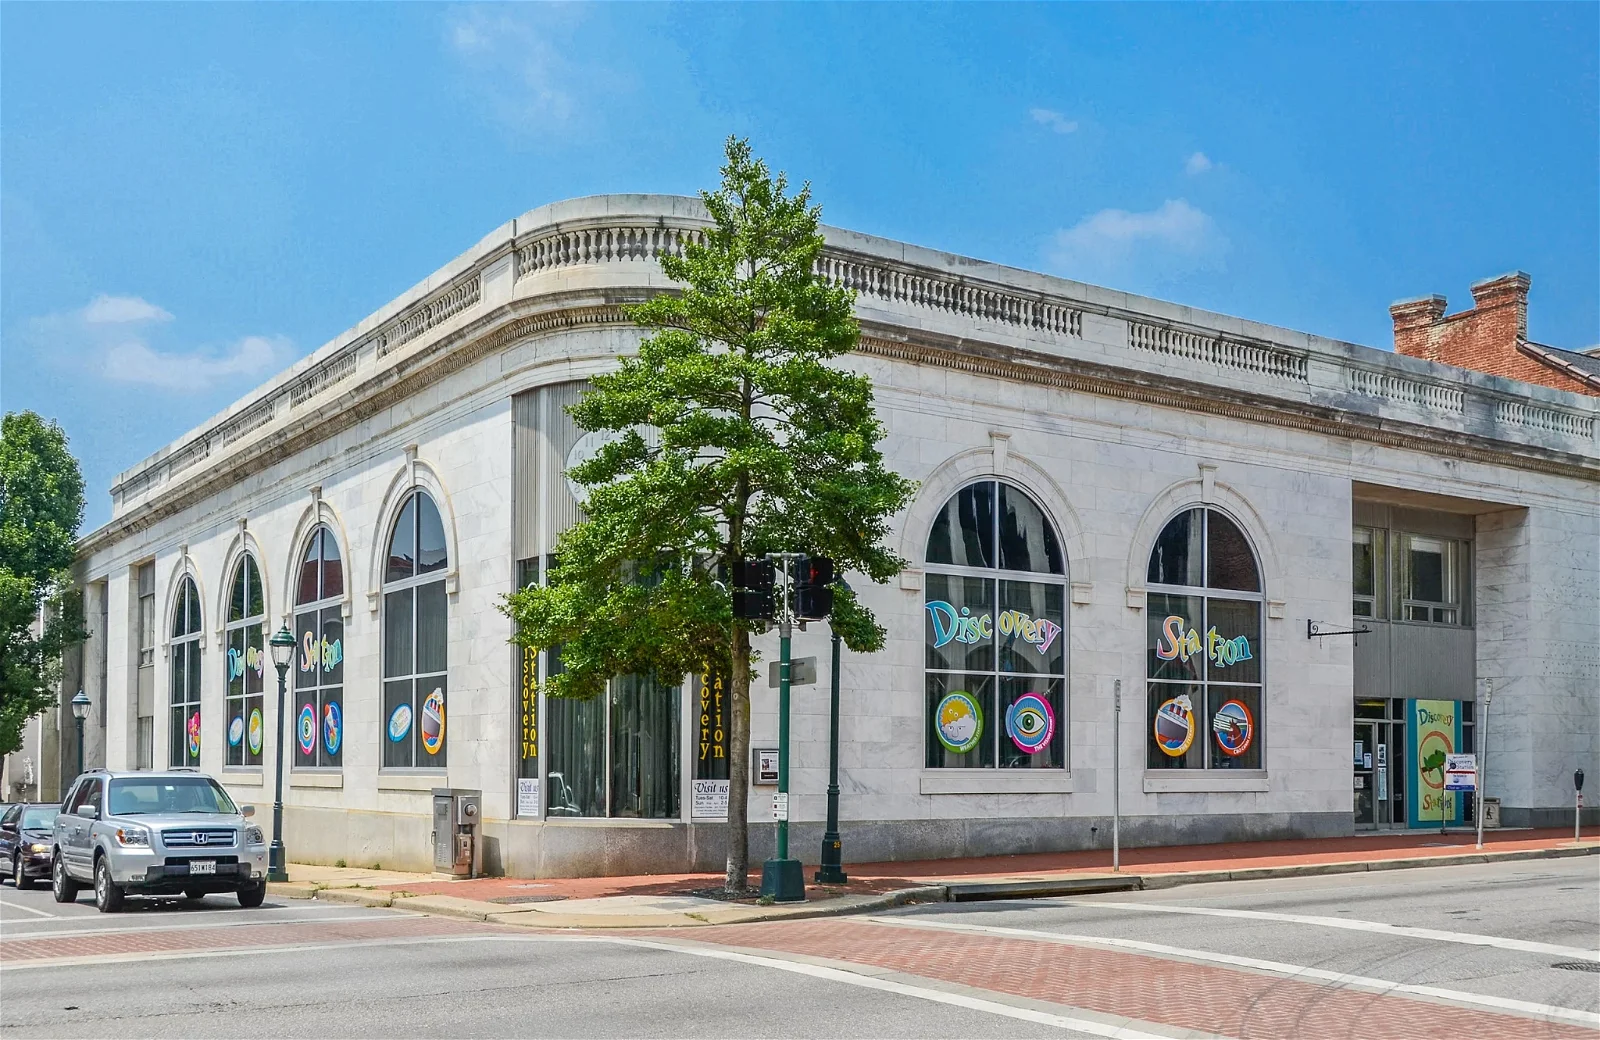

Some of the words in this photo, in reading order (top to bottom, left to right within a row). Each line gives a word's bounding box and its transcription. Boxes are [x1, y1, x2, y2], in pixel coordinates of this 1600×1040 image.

[574, 449, 584, 460] 10
[585, 436, 594, 448] 11
[925, 600, 1062, 655] Discovery
[1156, 615, 1253, 668] Station
[700, 660, 710, 760] scovery
[713, 677, 724, 758] ation
[694, 782, 716, 793] Visit
[719, 785, 728, 793] us
